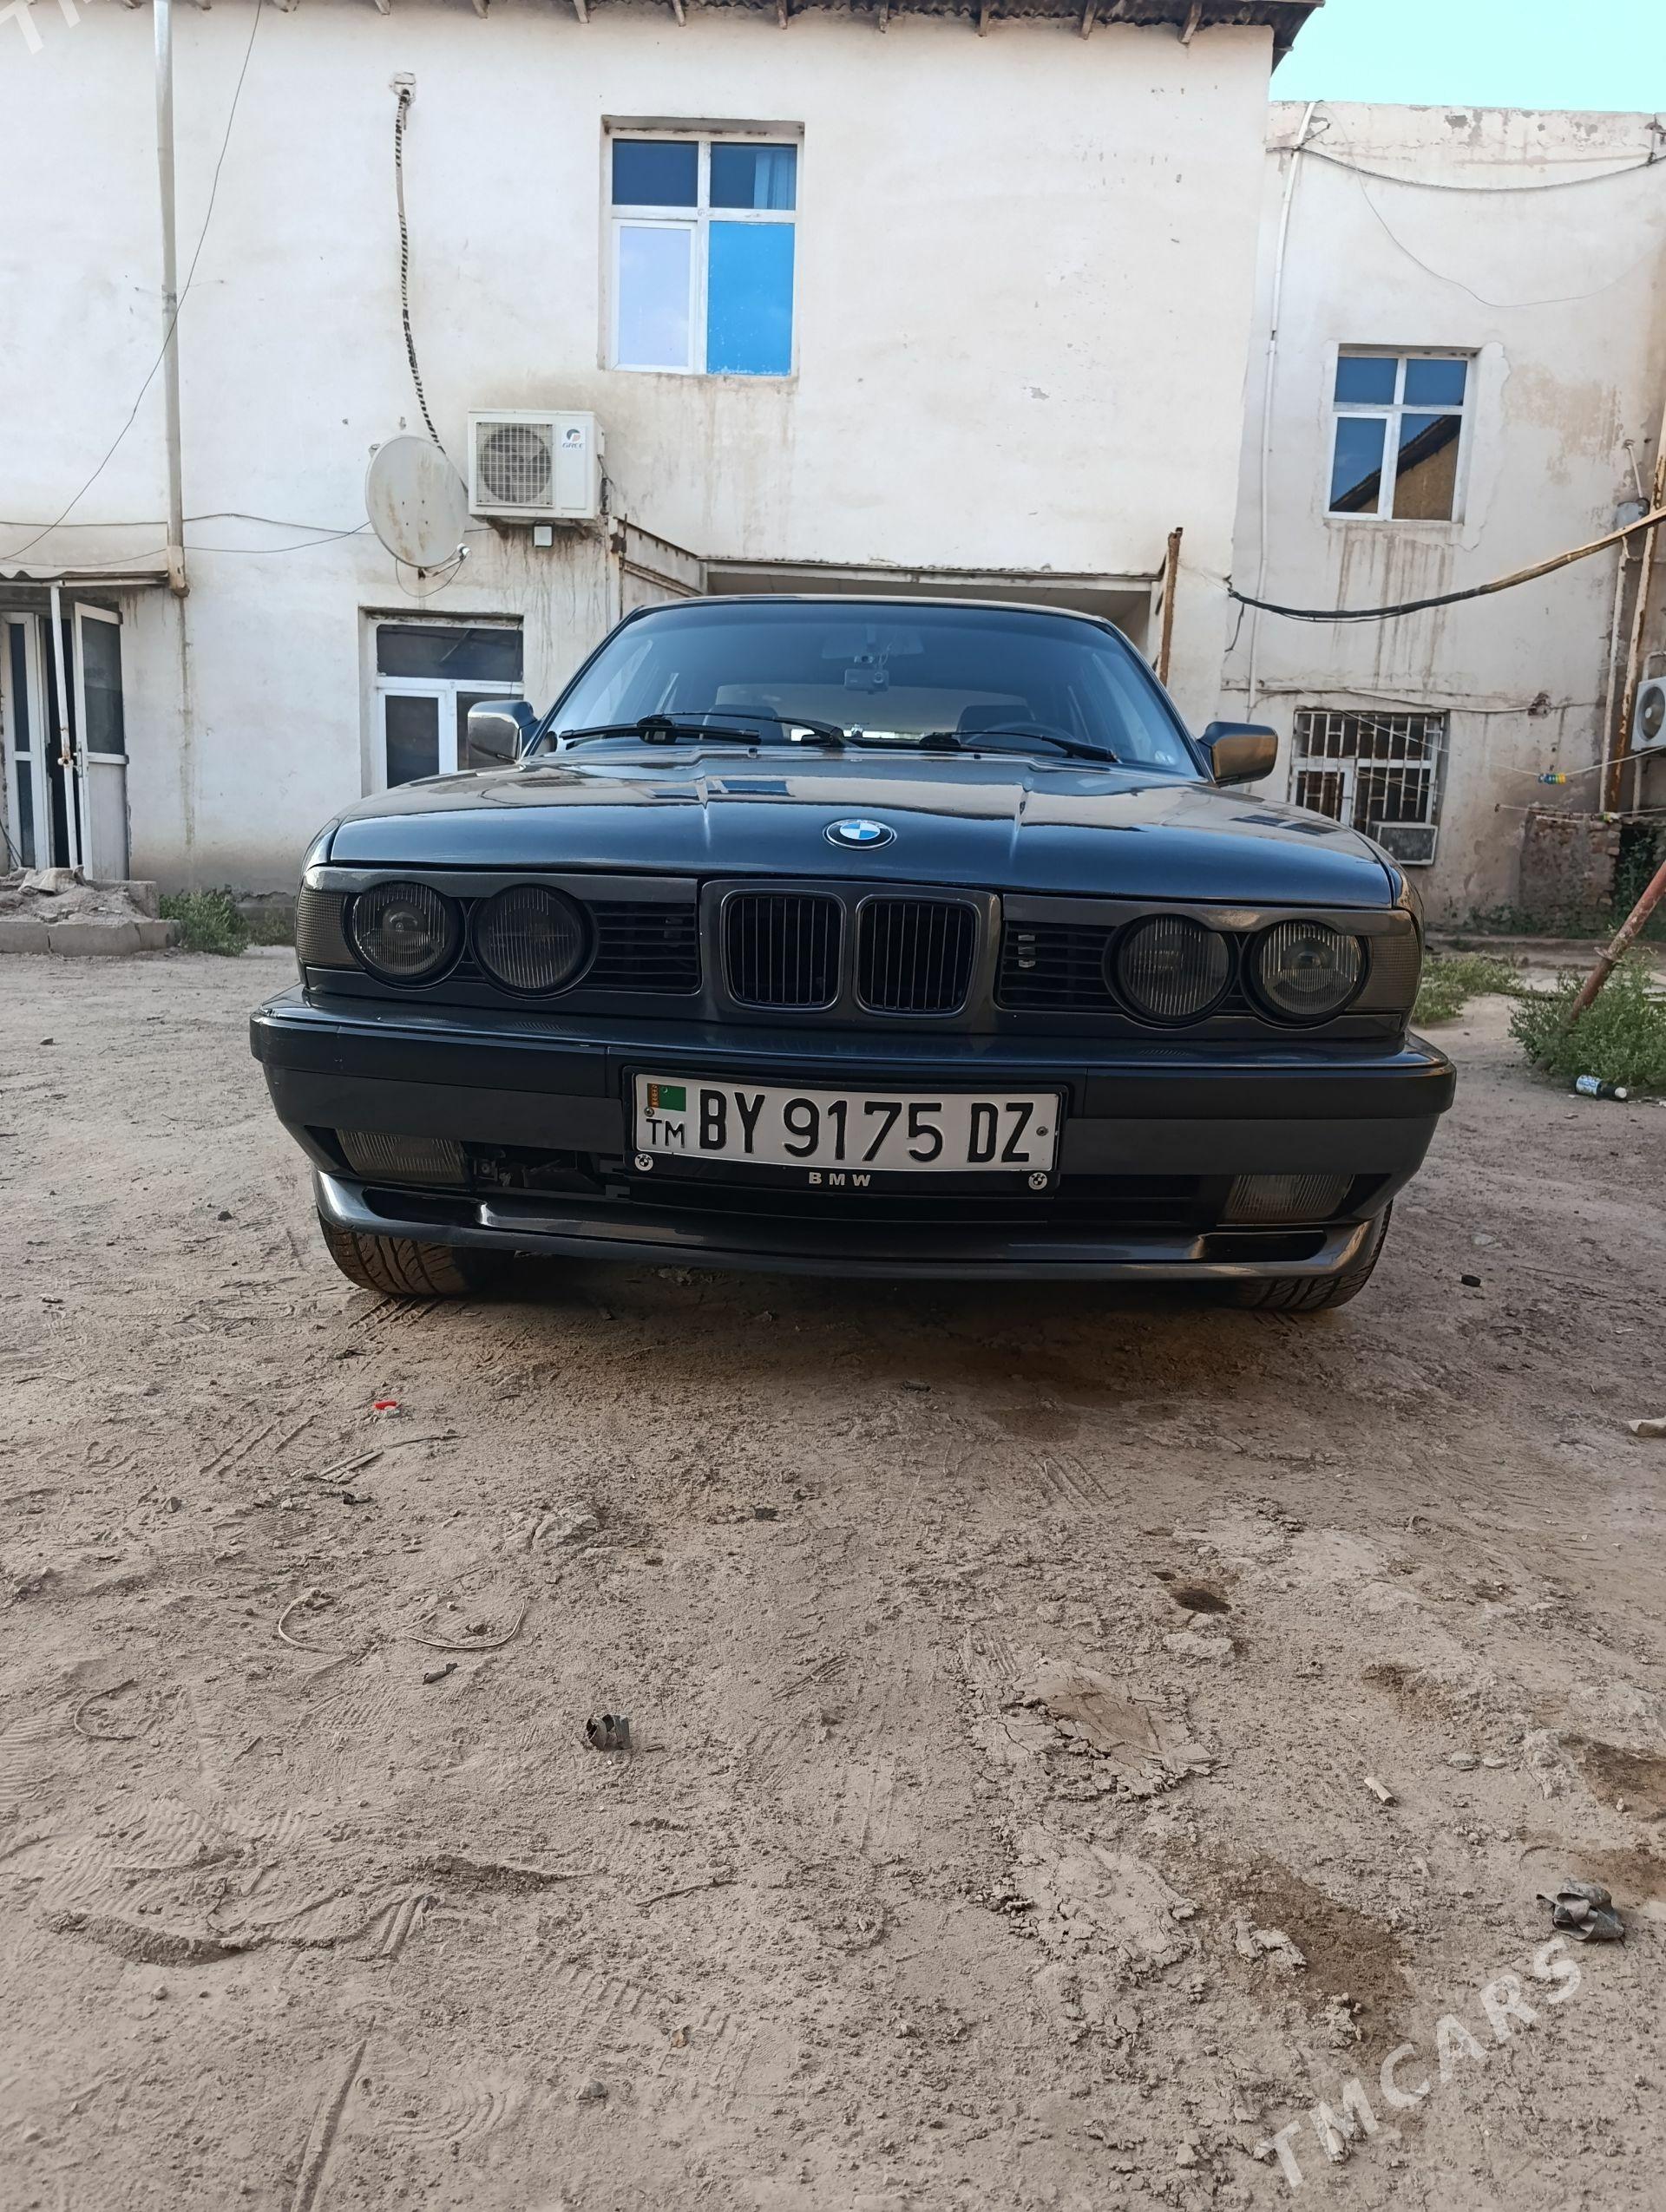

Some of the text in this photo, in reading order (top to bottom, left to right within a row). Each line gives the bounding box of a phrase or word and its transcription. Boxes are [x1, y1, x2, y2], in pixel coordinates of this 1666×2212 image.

[646, 1117, 685, 1148] TM
[699, 1089, 1033, 1162] BY 9175 DZ
